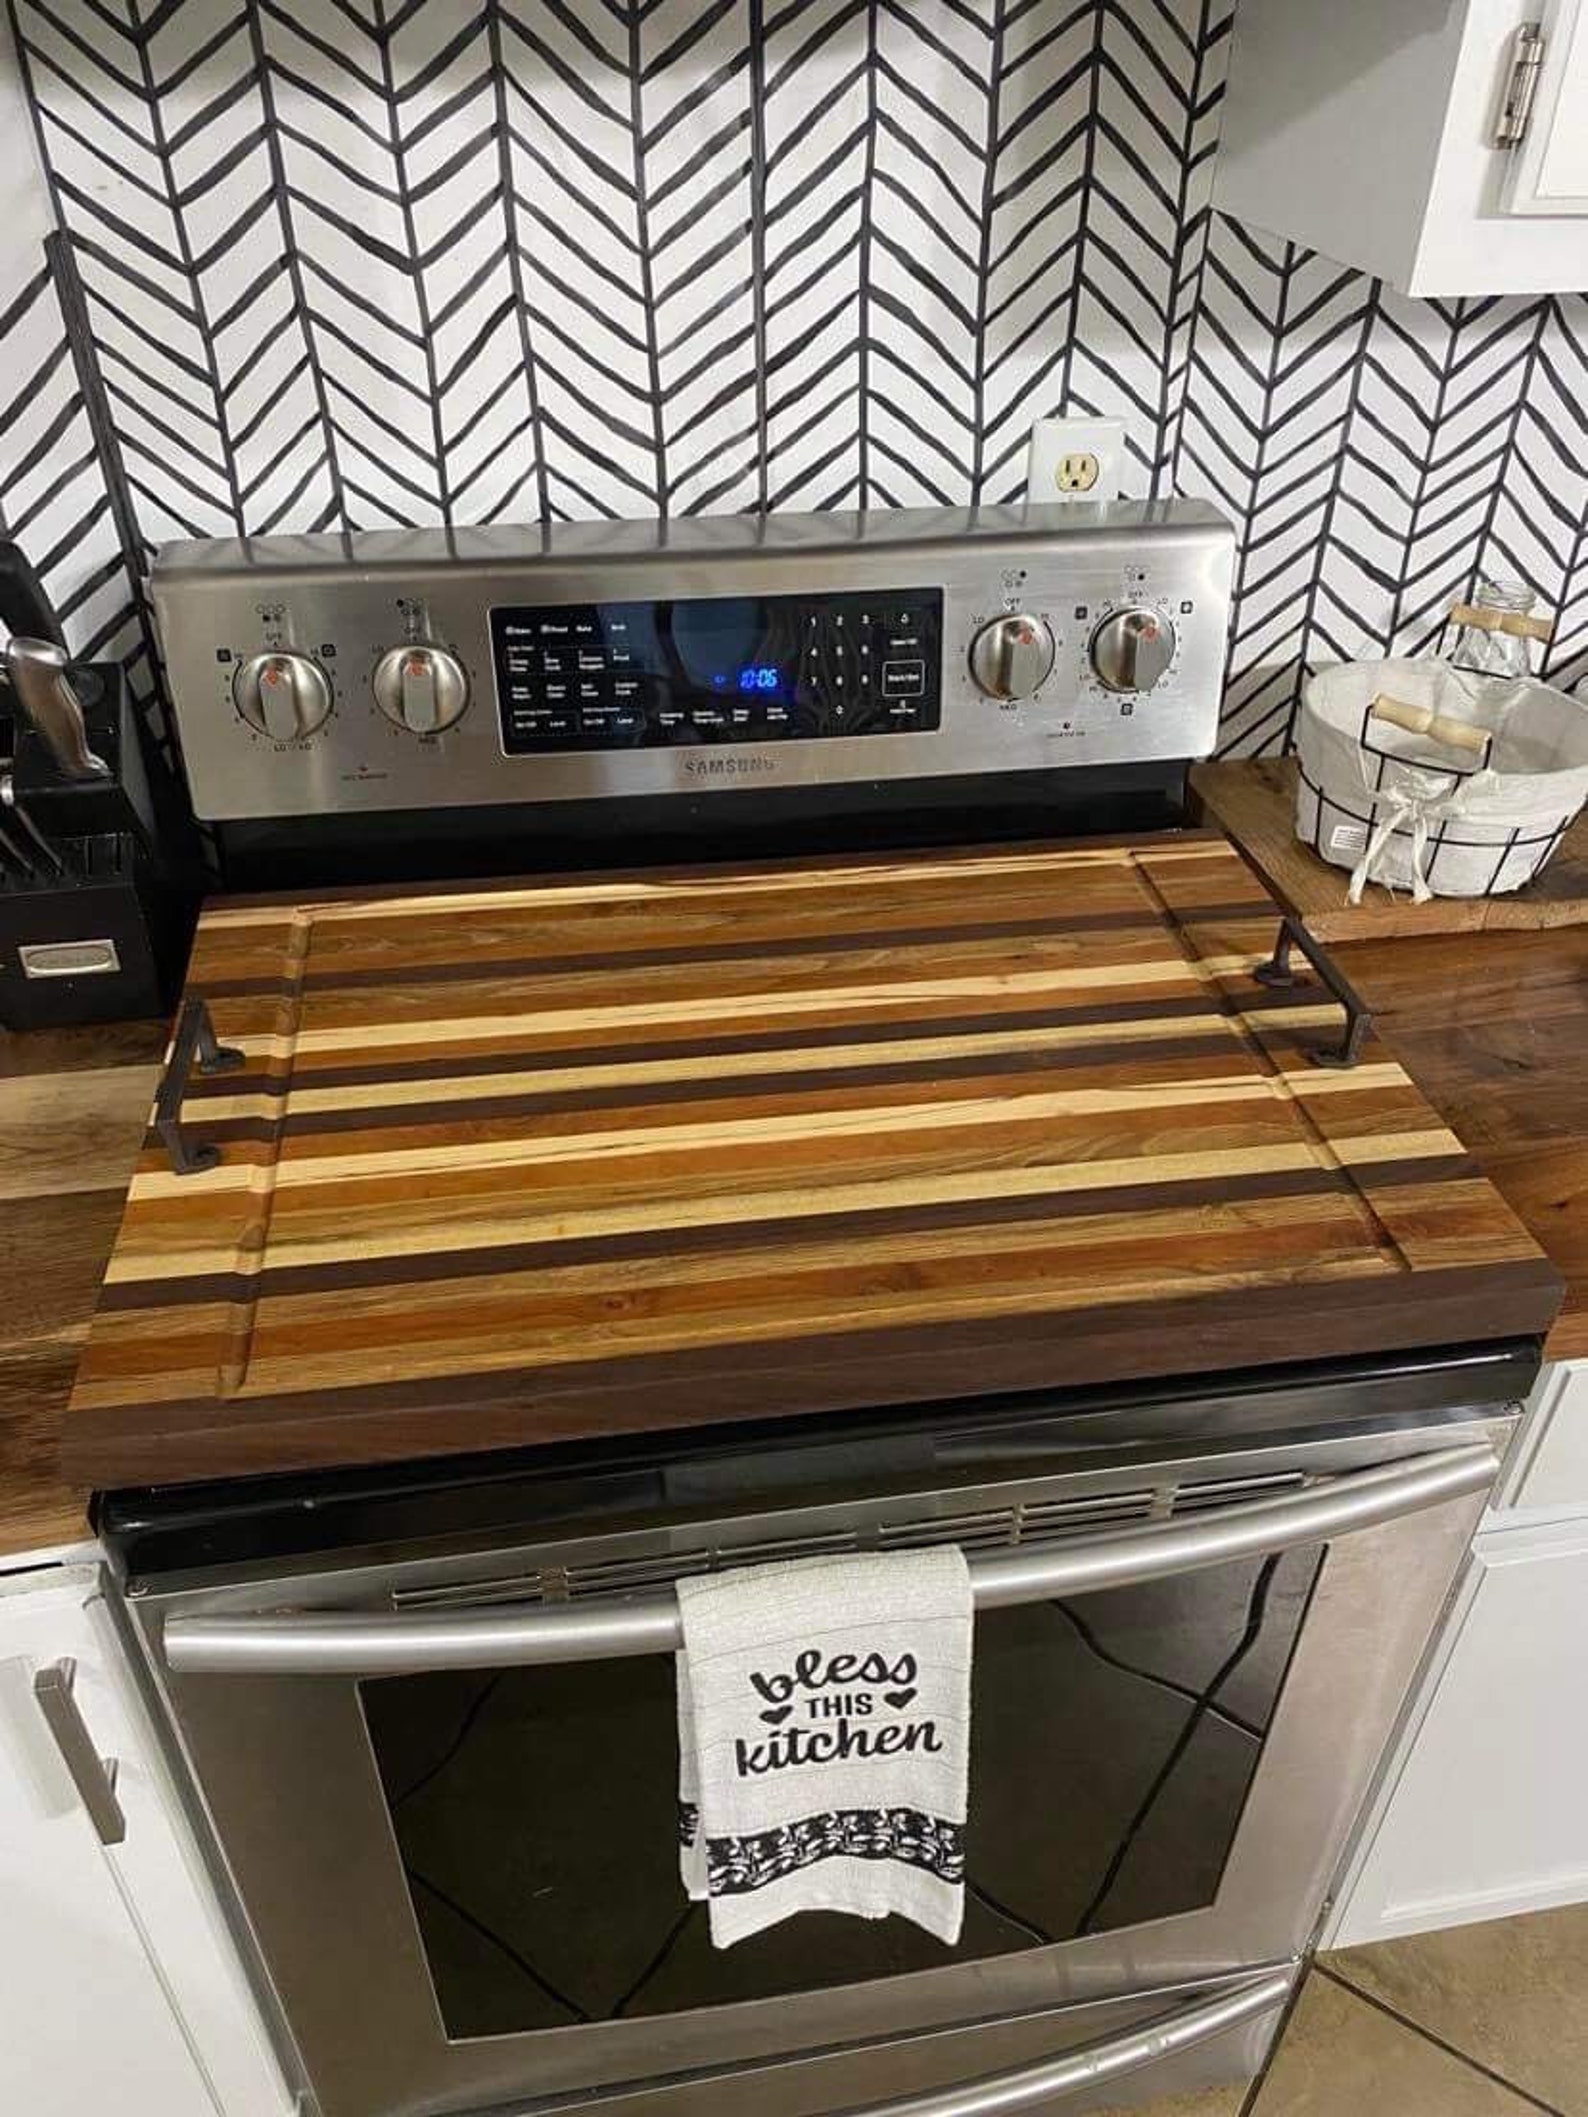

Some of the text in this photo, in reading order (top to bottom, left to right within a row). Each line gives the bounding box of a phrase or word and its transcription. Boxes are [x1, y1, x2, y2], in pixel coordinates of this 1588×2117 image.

[685, 756, 774, 775] SAMSUNG
[749, 1649, 918, 1703] bless
[804, 1693, 873, 1719] THIS
[735, 1718, 942, 1777] kitchen
